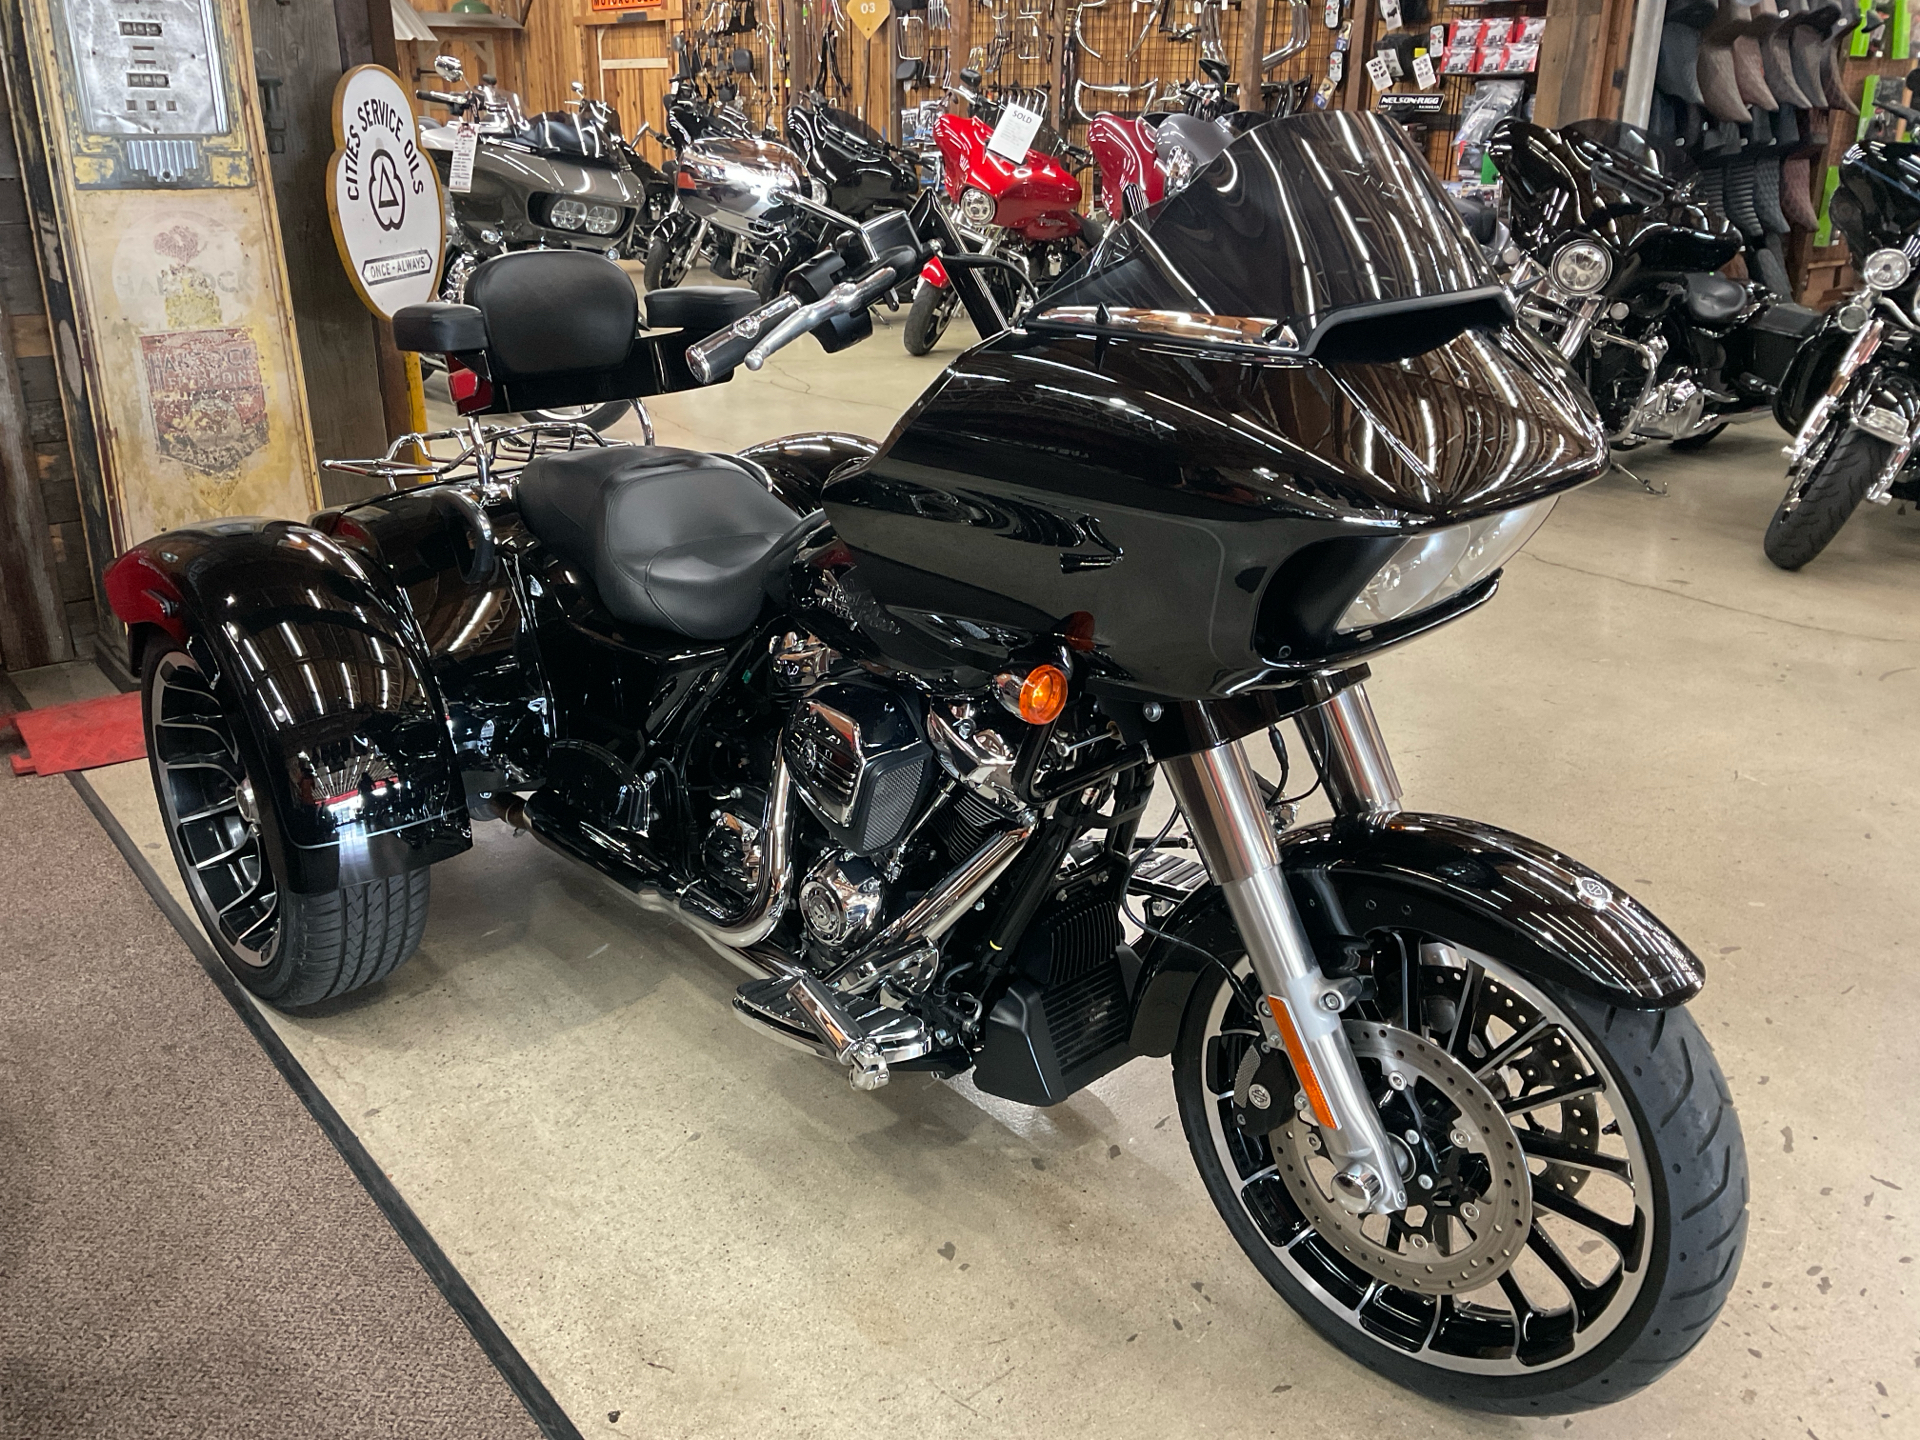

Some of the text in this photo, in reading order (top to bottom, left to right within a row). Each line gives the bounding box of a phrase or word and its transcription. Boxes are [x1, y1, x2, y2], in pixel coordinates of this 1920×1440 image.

[861, 2, 876, 14] 03
[1012, 110, 1033, 124] SOLD
[345, 124, 361, 201] CITIES
[357, 99, 404, 143] SERVICE
[404, 140, 424, 195] OILS
